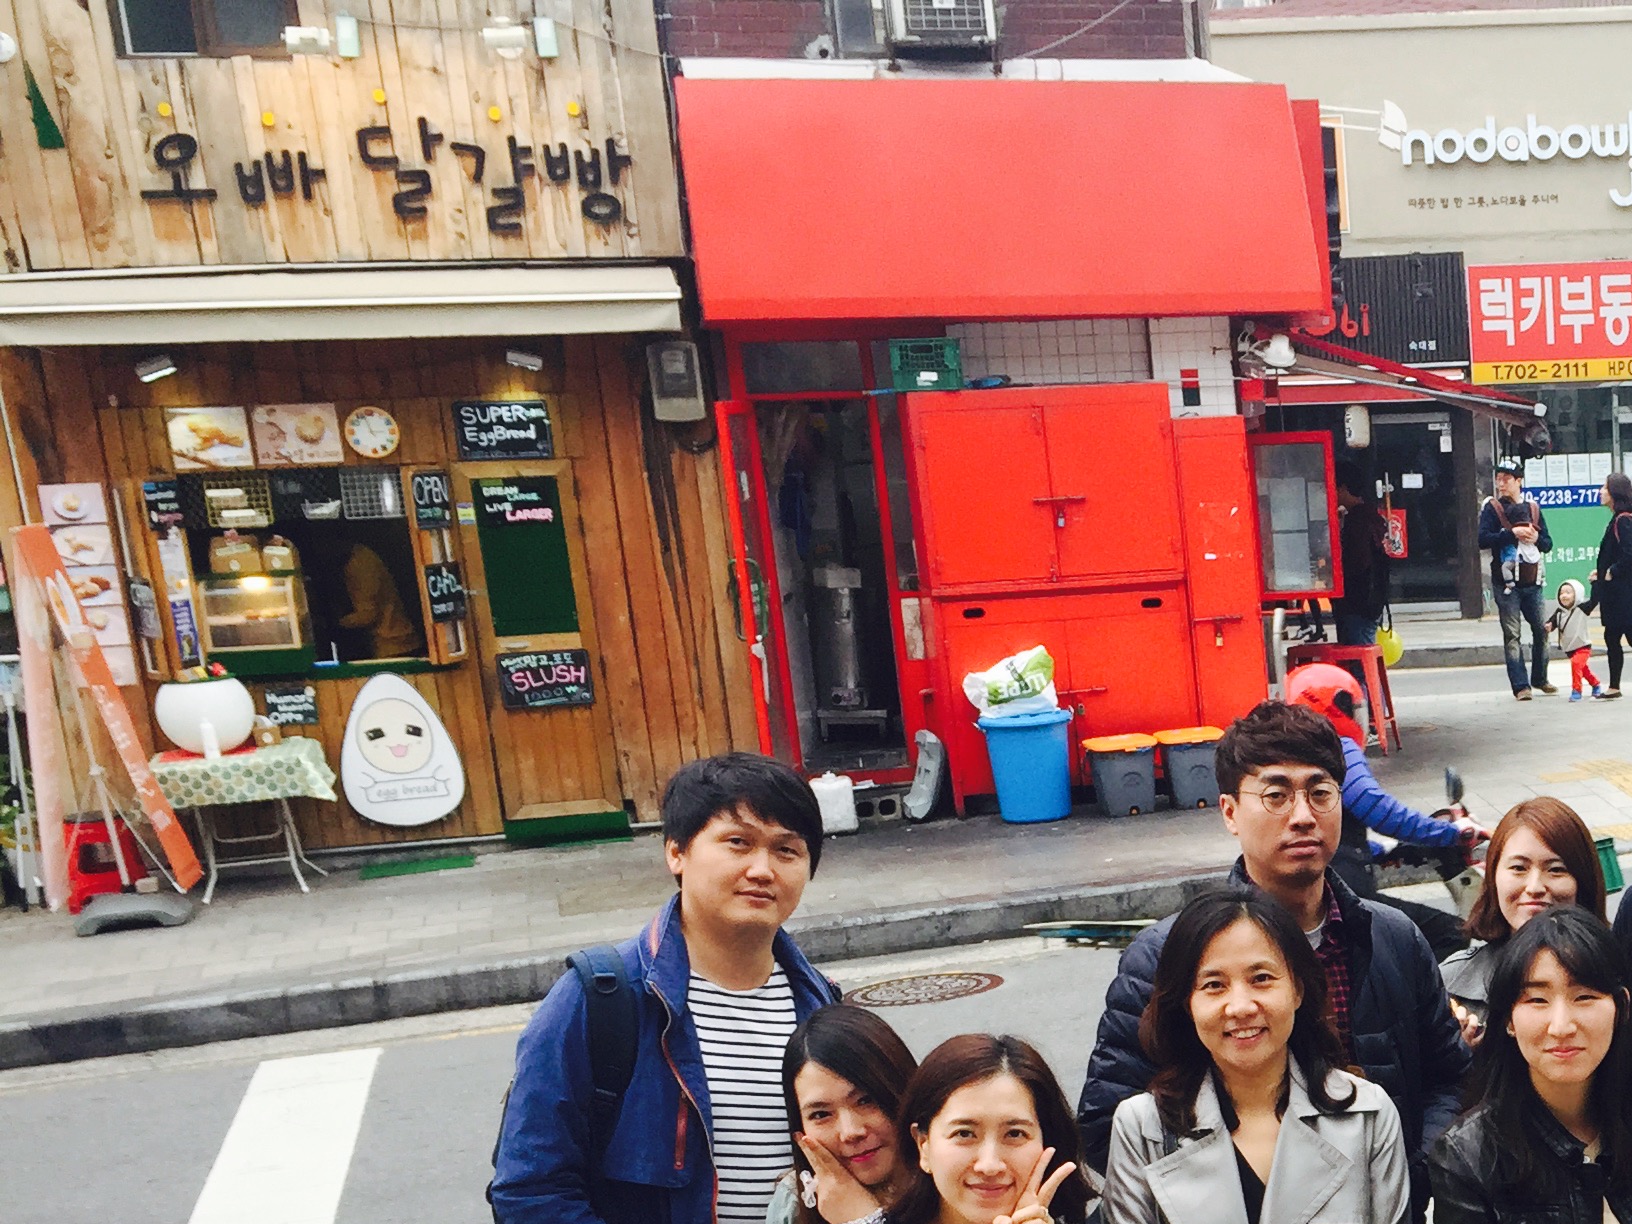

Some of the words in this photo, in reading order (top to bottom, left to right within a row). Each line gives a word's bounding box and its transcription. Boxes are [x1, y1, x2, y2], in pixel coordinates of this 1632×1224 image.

[459, 404, 527, 425] SUPER
[411, 475, 449, 505] OPEN
[511, 664, 586, 692] SLUSH
